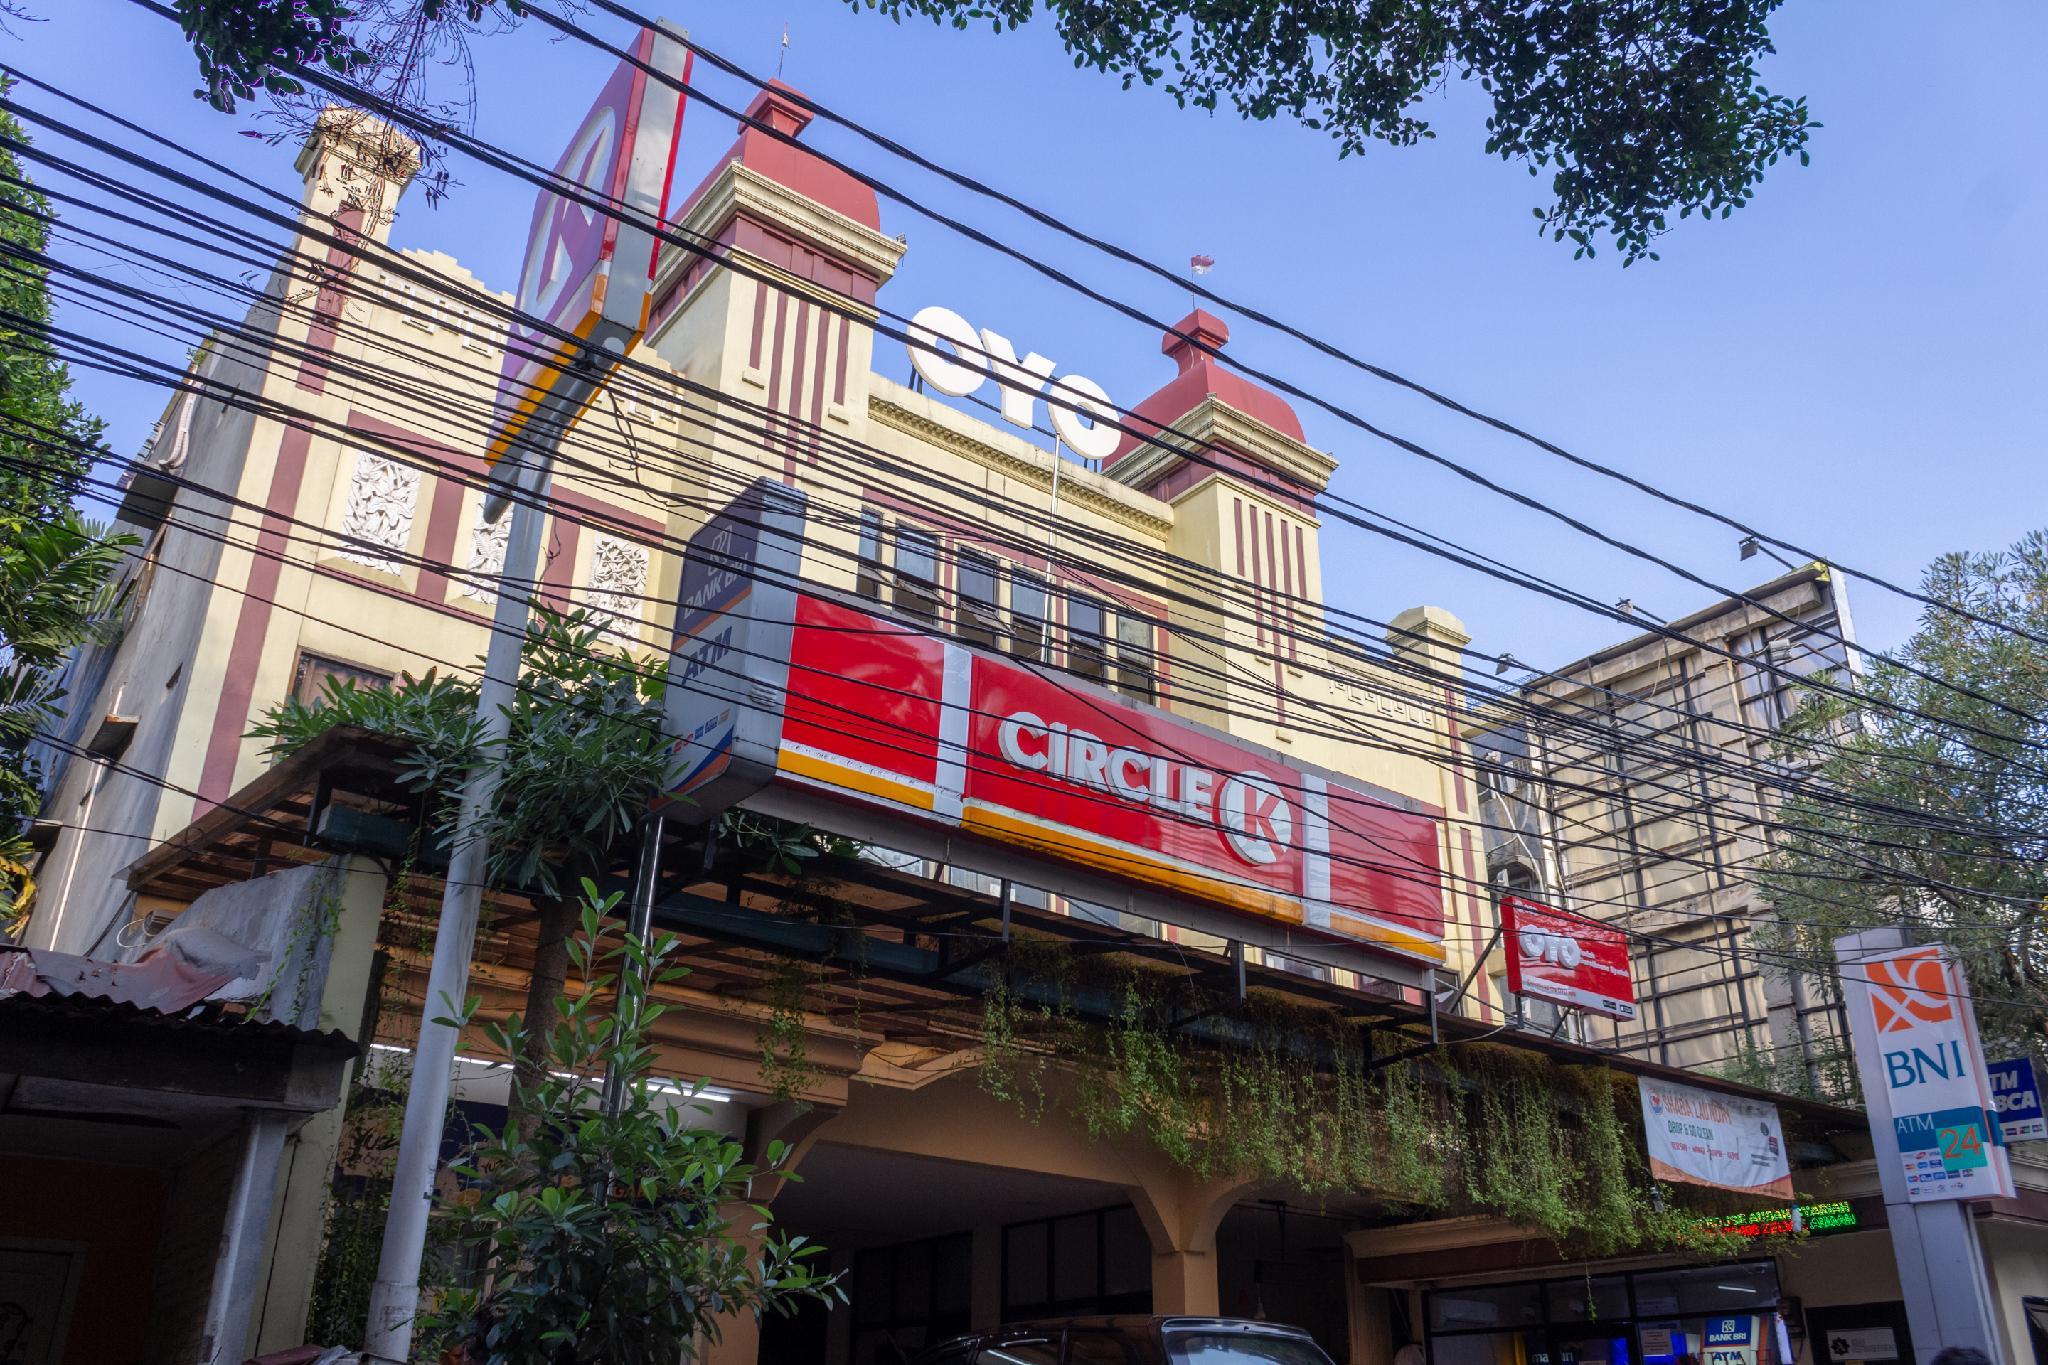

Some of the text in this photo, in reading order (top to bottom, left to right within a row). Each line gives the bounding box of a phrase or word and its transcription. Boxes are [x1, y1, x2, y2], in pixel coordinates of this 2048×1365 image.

[907, 306, 1122, 461] OYO
[684, 571, 721, 620] BANK
[681, 626, 732, 686] ATM
[998, 711, 1290, 863] CIRCLE K
[1884, 1040, 1966, 1088] BNI
[1989, 1070, 2018, 1091] TM
[1993, 1090, 2037, 1113] BCA
[1897, 1114, 1934, 1134] ATM
[1941, 1125, 1982, 1159] 24
[1709, 1332, 1747, 1342] BANK BRI
[1713, 1351, 1743, 1361] ATM
